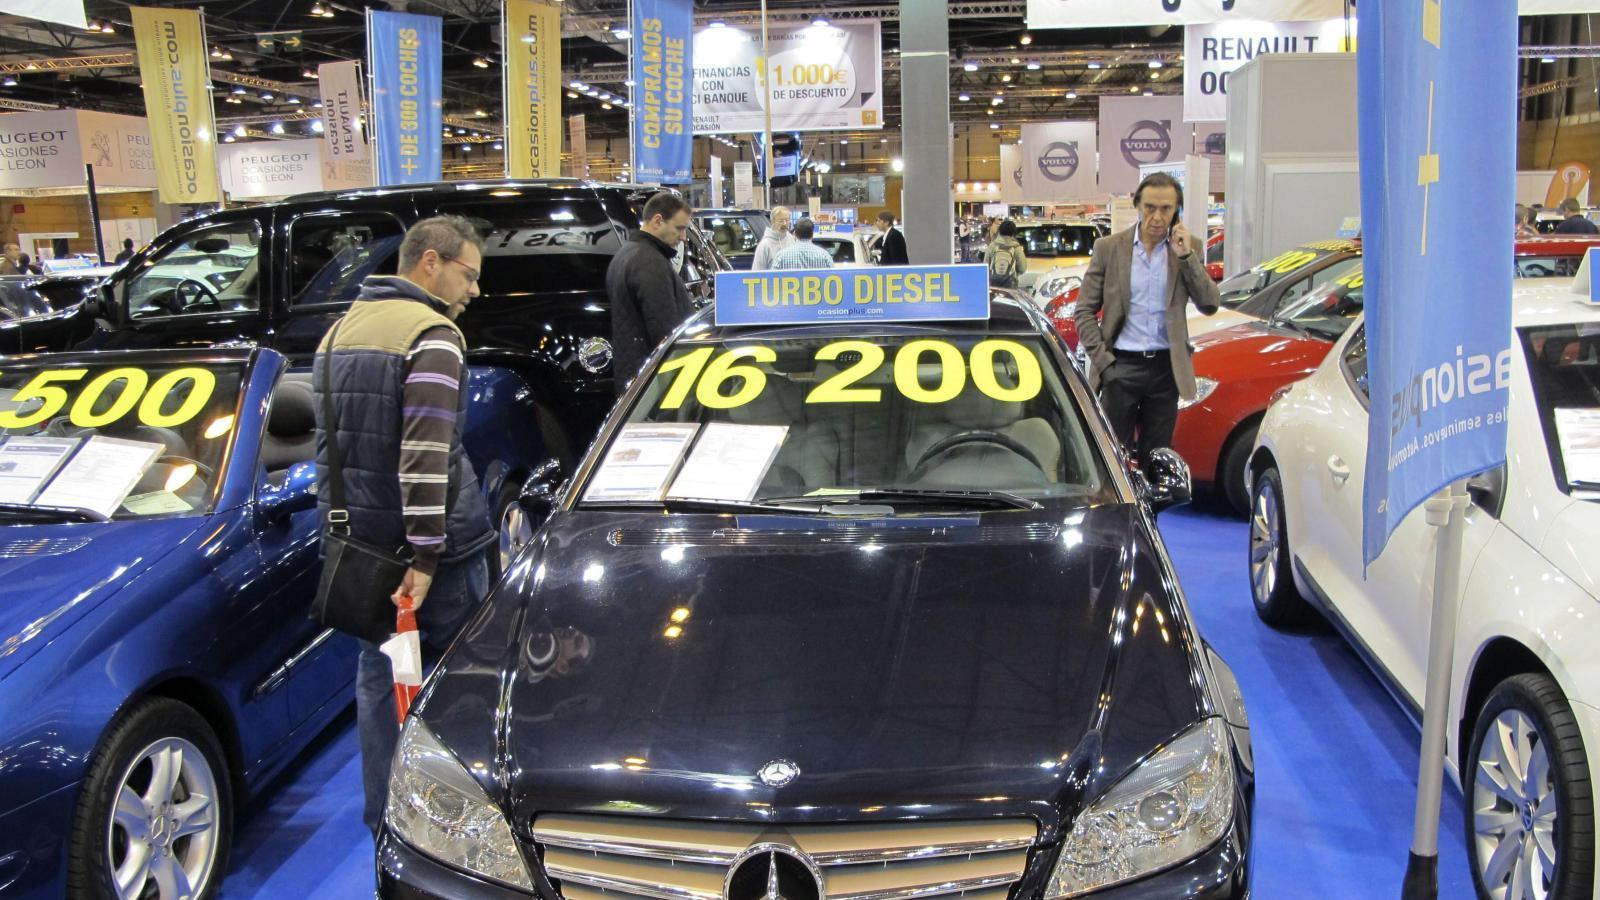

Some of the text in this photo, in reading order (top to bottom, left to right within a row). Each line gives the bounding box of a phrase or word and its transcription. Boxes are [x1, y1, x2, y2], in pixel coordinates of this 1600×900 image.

[1202, 36, 1319, 60] RENAULT
[399, 28, 418, 96] COCHES
[692, 66, 751, 79] FINANCIAS
[642, 18, 662, 149] COMPRAMOS
[665, 37, 684, 135] SU COCHE
[702, 81, 724, 91] CON
[773, 63, 847, 87] 1.000€
[704, 92, 748, 105] BANQUE
[773, 90, 786, 100] DE
[400, 99, 418, 131] 300
[400, 134, 418, 156] DE
[1124, 141, 1167, 149] VOLVO
[241, 153, 310, 164] PEUGEOT
[1041, 158, 1077, 166] VOLVO
[742, 272, 960, 307] TURBO DIESEL
[817, 306, 884, 317] ocasionplus.com
[657, 339, 1043, 410] 16 200
[0, 367, 216, 429] 500
